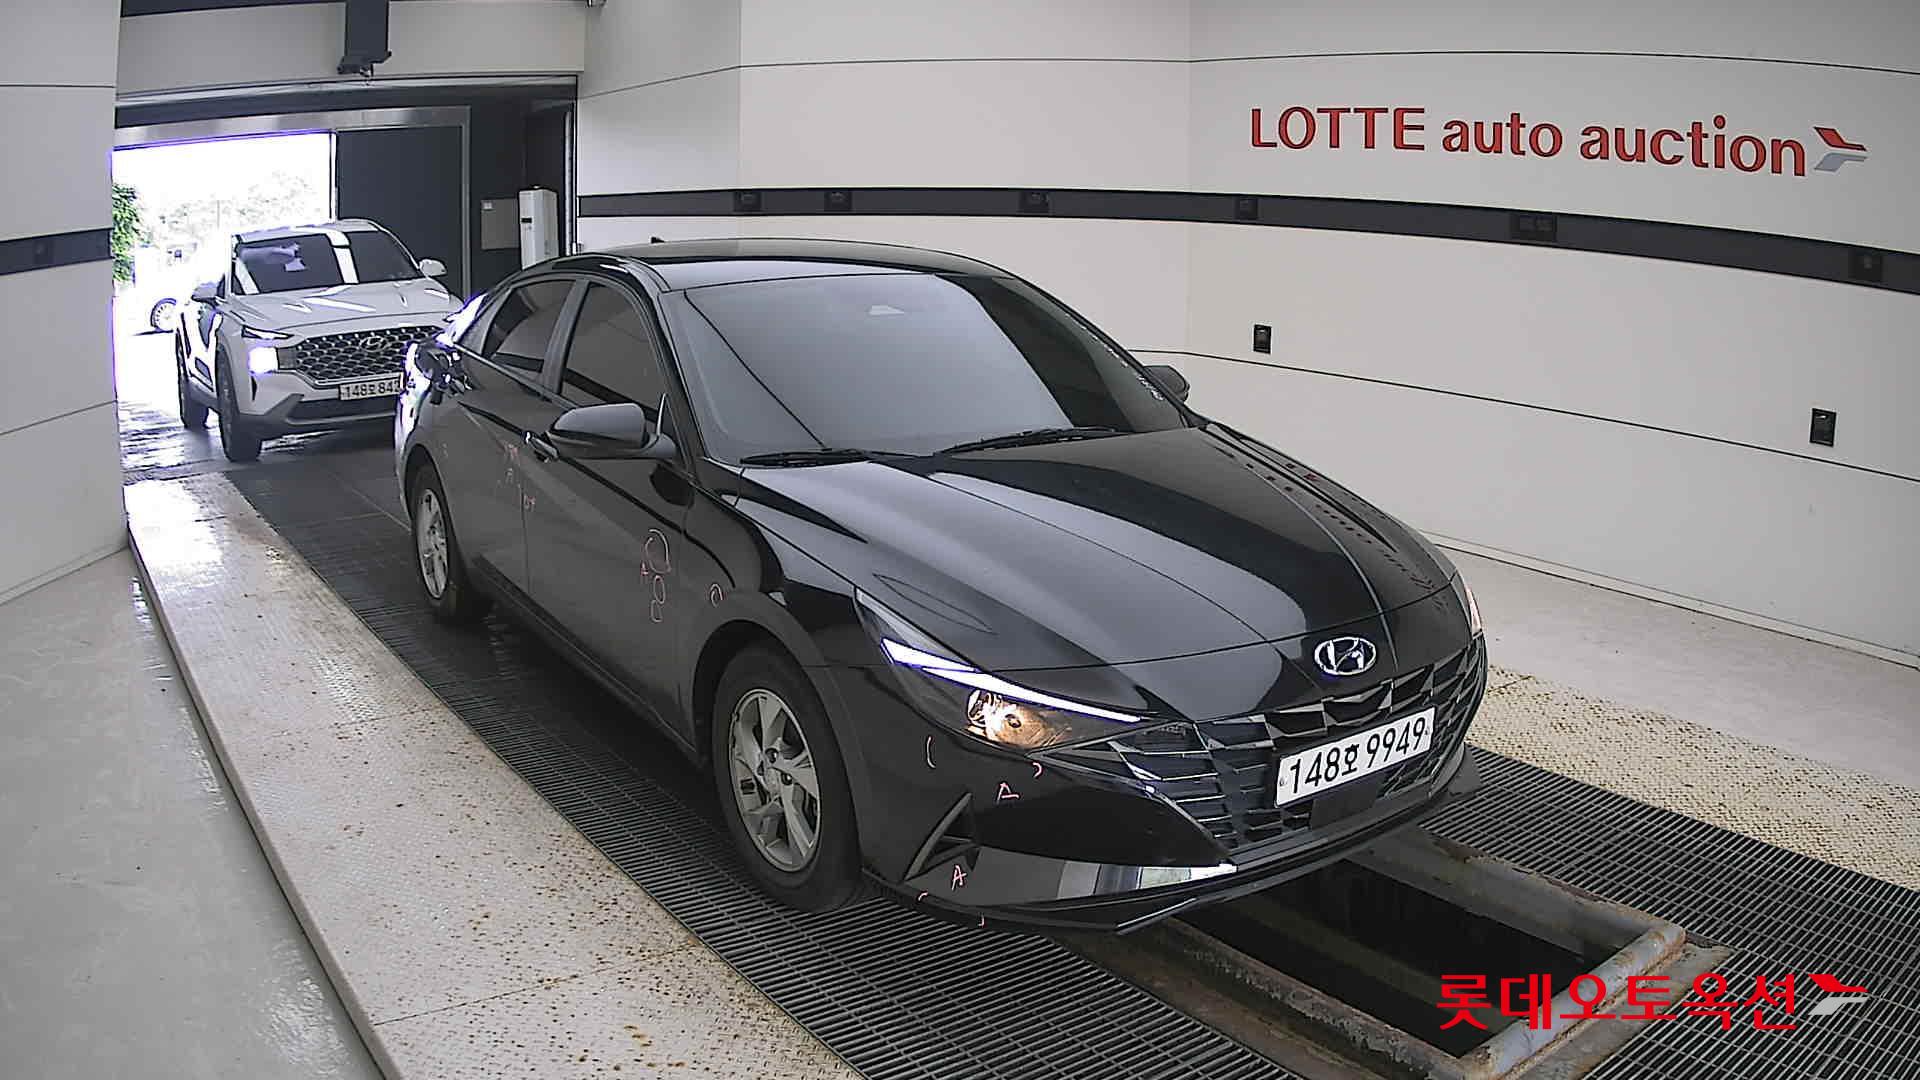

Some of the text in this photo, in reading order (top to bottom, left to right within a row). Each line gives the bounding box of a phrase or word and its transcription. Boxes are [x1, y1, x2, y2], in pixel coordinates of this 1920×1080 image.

[1250, 107, 1806, 176] LOTTE auto auction
[1290, 717, 1426, 794] 148호 9949
